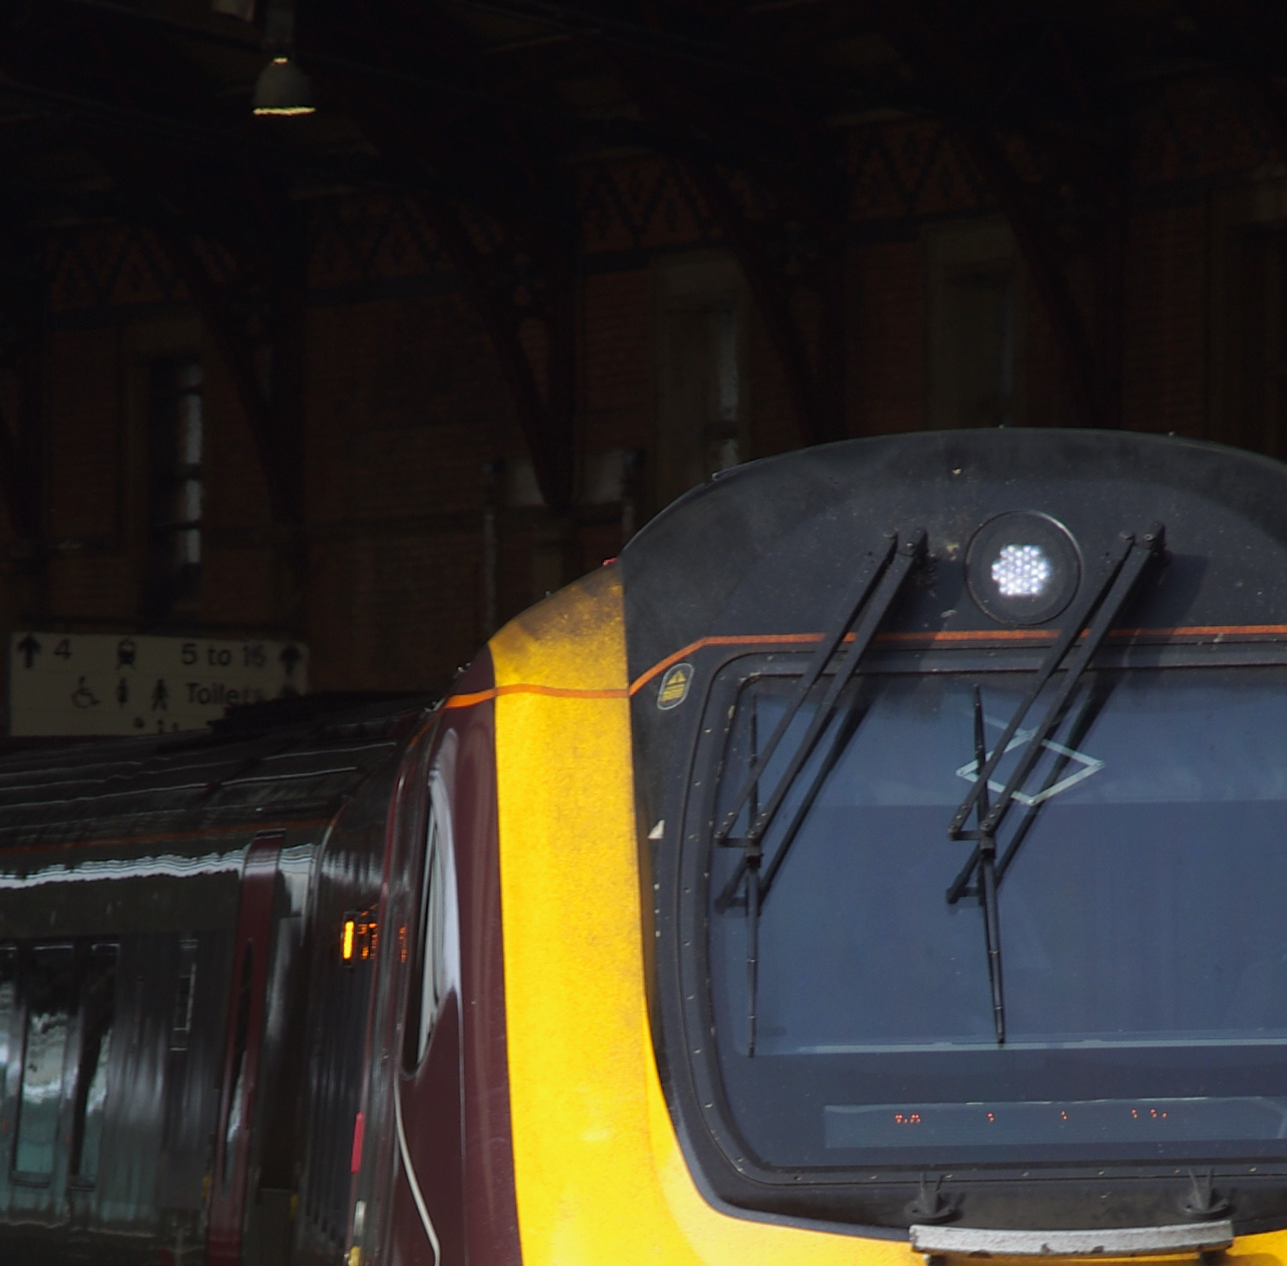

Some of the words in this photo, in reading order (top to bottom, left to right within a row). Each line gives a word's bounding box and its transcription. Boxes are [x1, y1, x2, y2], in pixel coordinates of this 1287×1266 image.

[53, 638, 72, 661] 4
[180, 643, 199, 665] 5
[207, 645, 233, 666] to
